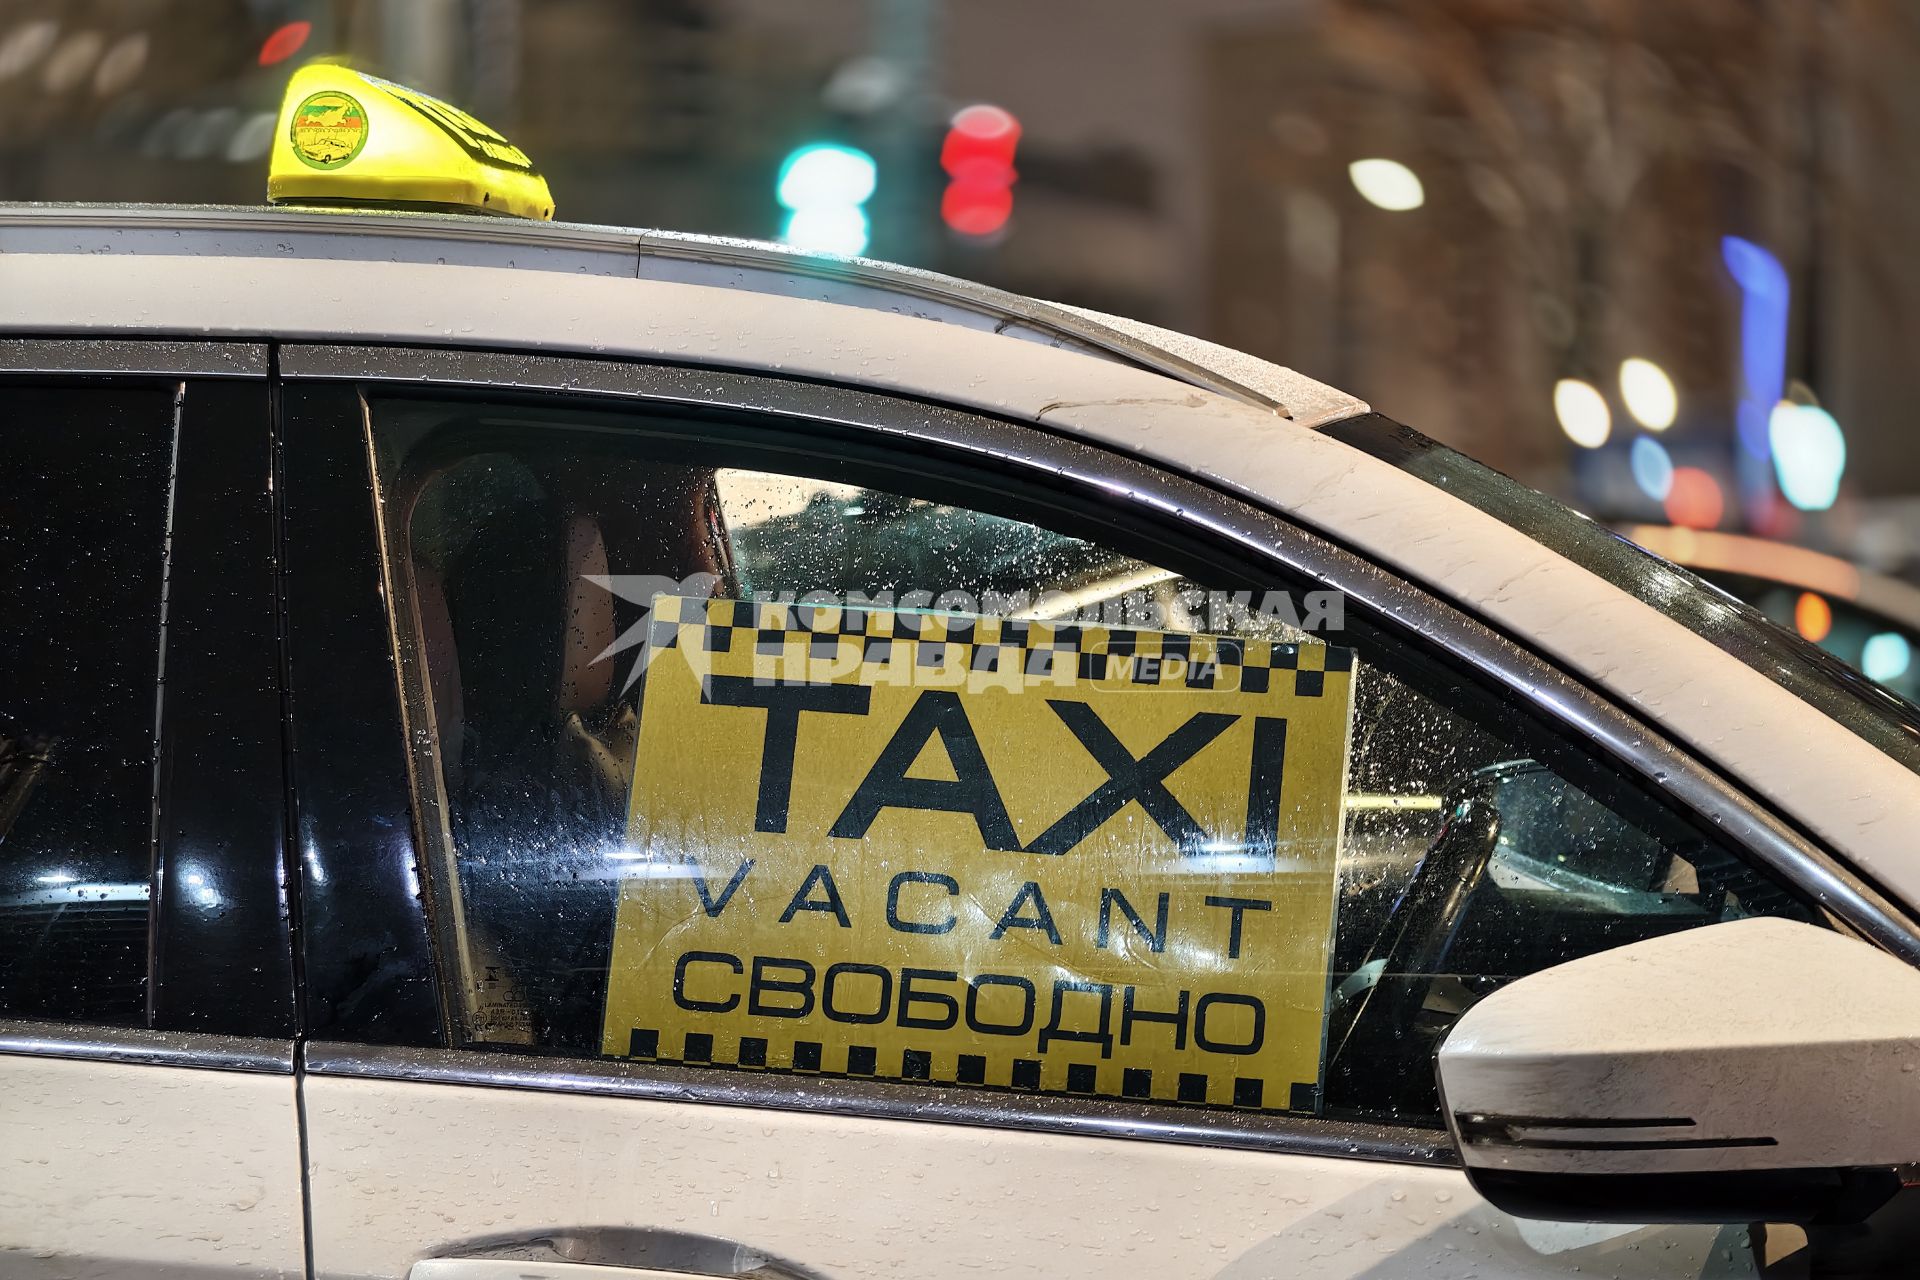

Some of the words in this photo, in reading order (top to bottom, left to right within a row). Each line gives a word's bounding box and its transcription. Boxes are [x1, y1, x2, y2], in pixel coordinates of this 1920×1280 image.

[700, 674, 1287, 870] TAXI
[685, 854, 1272, 960] VACANT
[672, 950, 1267, 1060] СВОБОДНО
